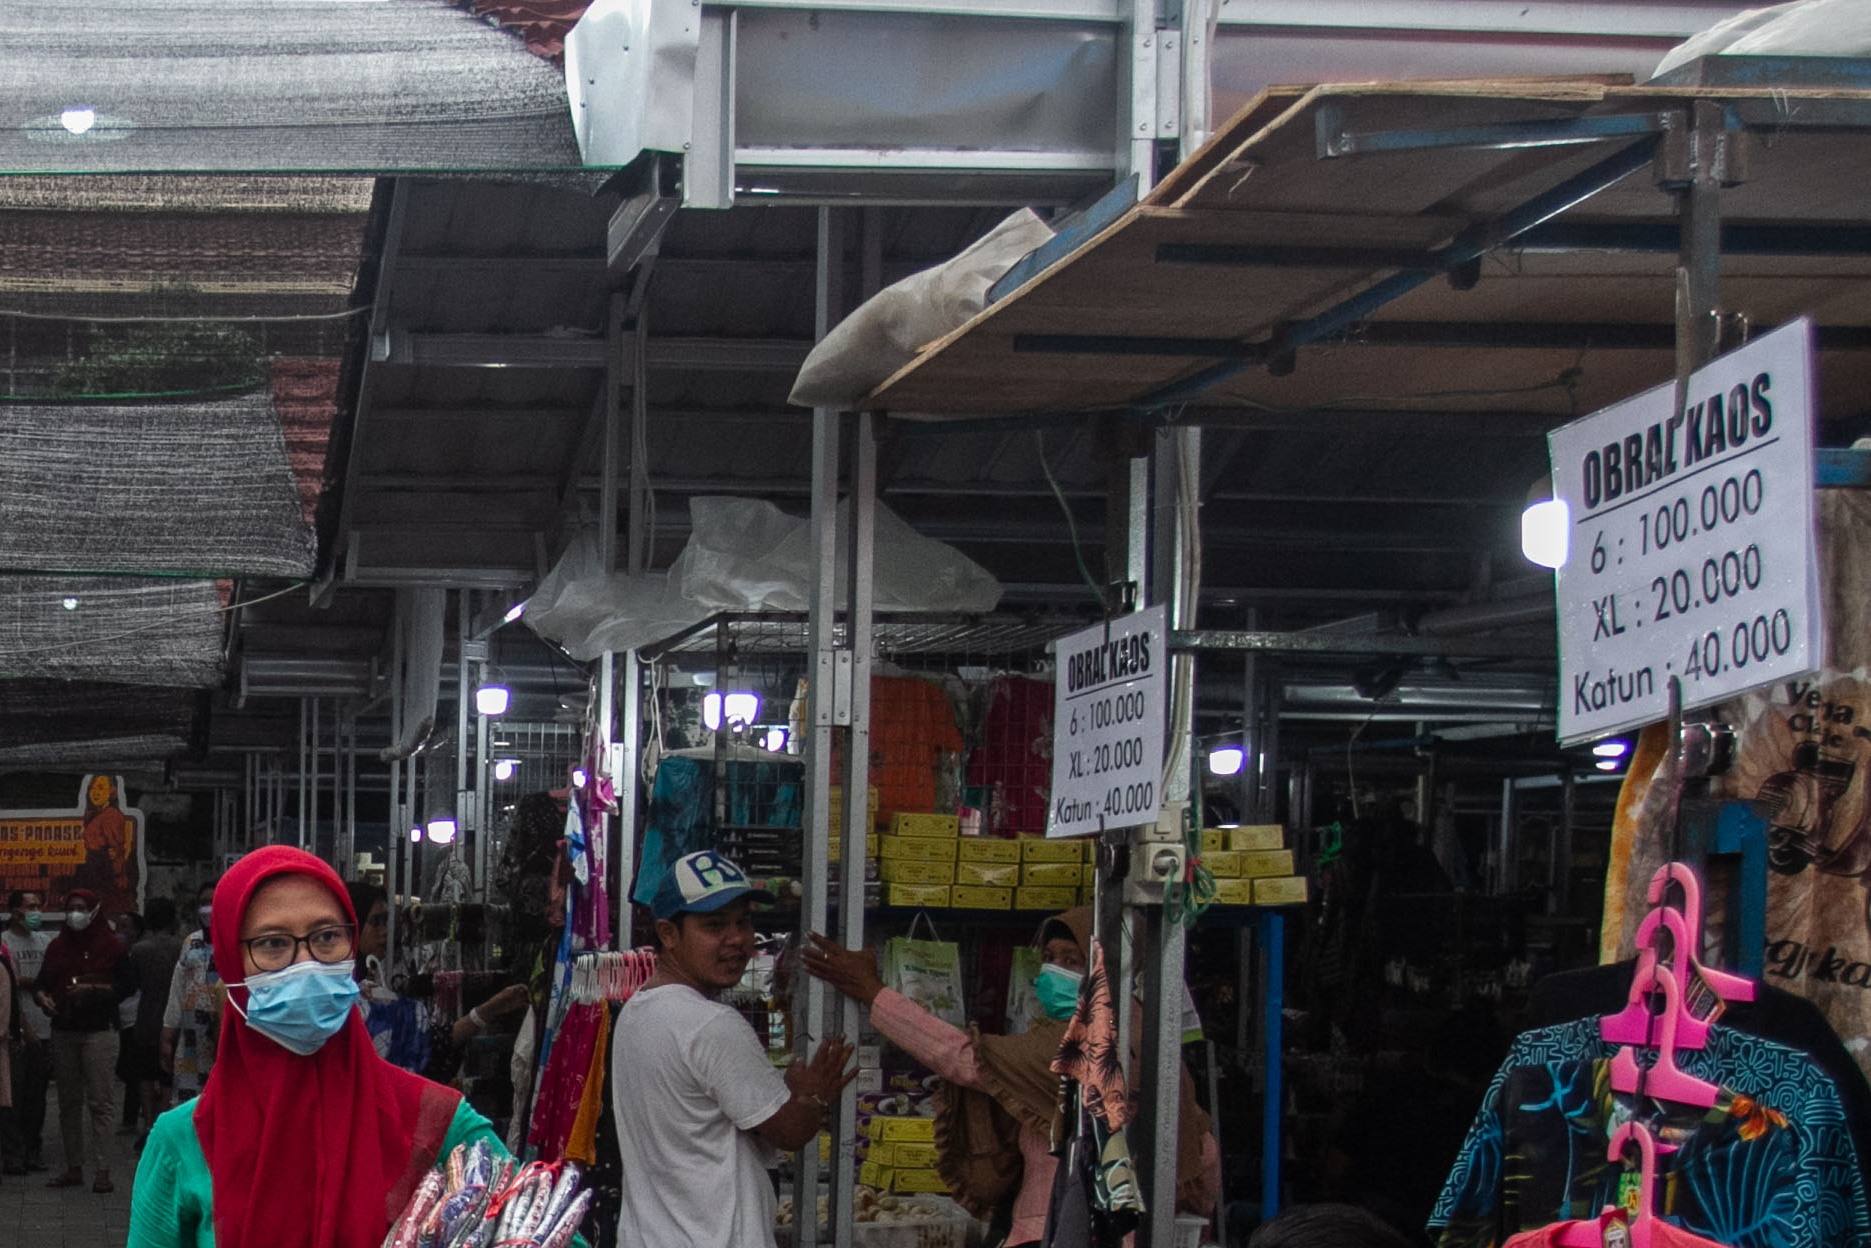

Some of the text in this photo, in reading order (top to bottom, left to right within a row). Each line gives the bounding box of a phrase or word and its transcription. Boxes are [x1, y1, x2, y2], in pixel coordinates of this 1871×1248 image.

[1583, 372, 1772, 509] OBRAL KAOS
[1590, 530, 1605, 574] 6
[1639, 469, 1762, 557] 100.000
[1592, 593, 1626, 642] XL
[1651, 544, 1762, 622] 20.000
[1068, 631, 1150, 693] OBRAL KAOS
[1573, 664, 1653, 715] Katun
[1684, 608, 1791, 681] 40.000
[1070, 707, 1077, 736] 6
[1089, 690, 1145, 730] 100.000
[1068, 752, 1083, 779] XL
[1093, 737, 1143, 774] 20.000
[1055, 796, 1091, 824] Katun
[1103, 781, 1153, 816] 40.000
